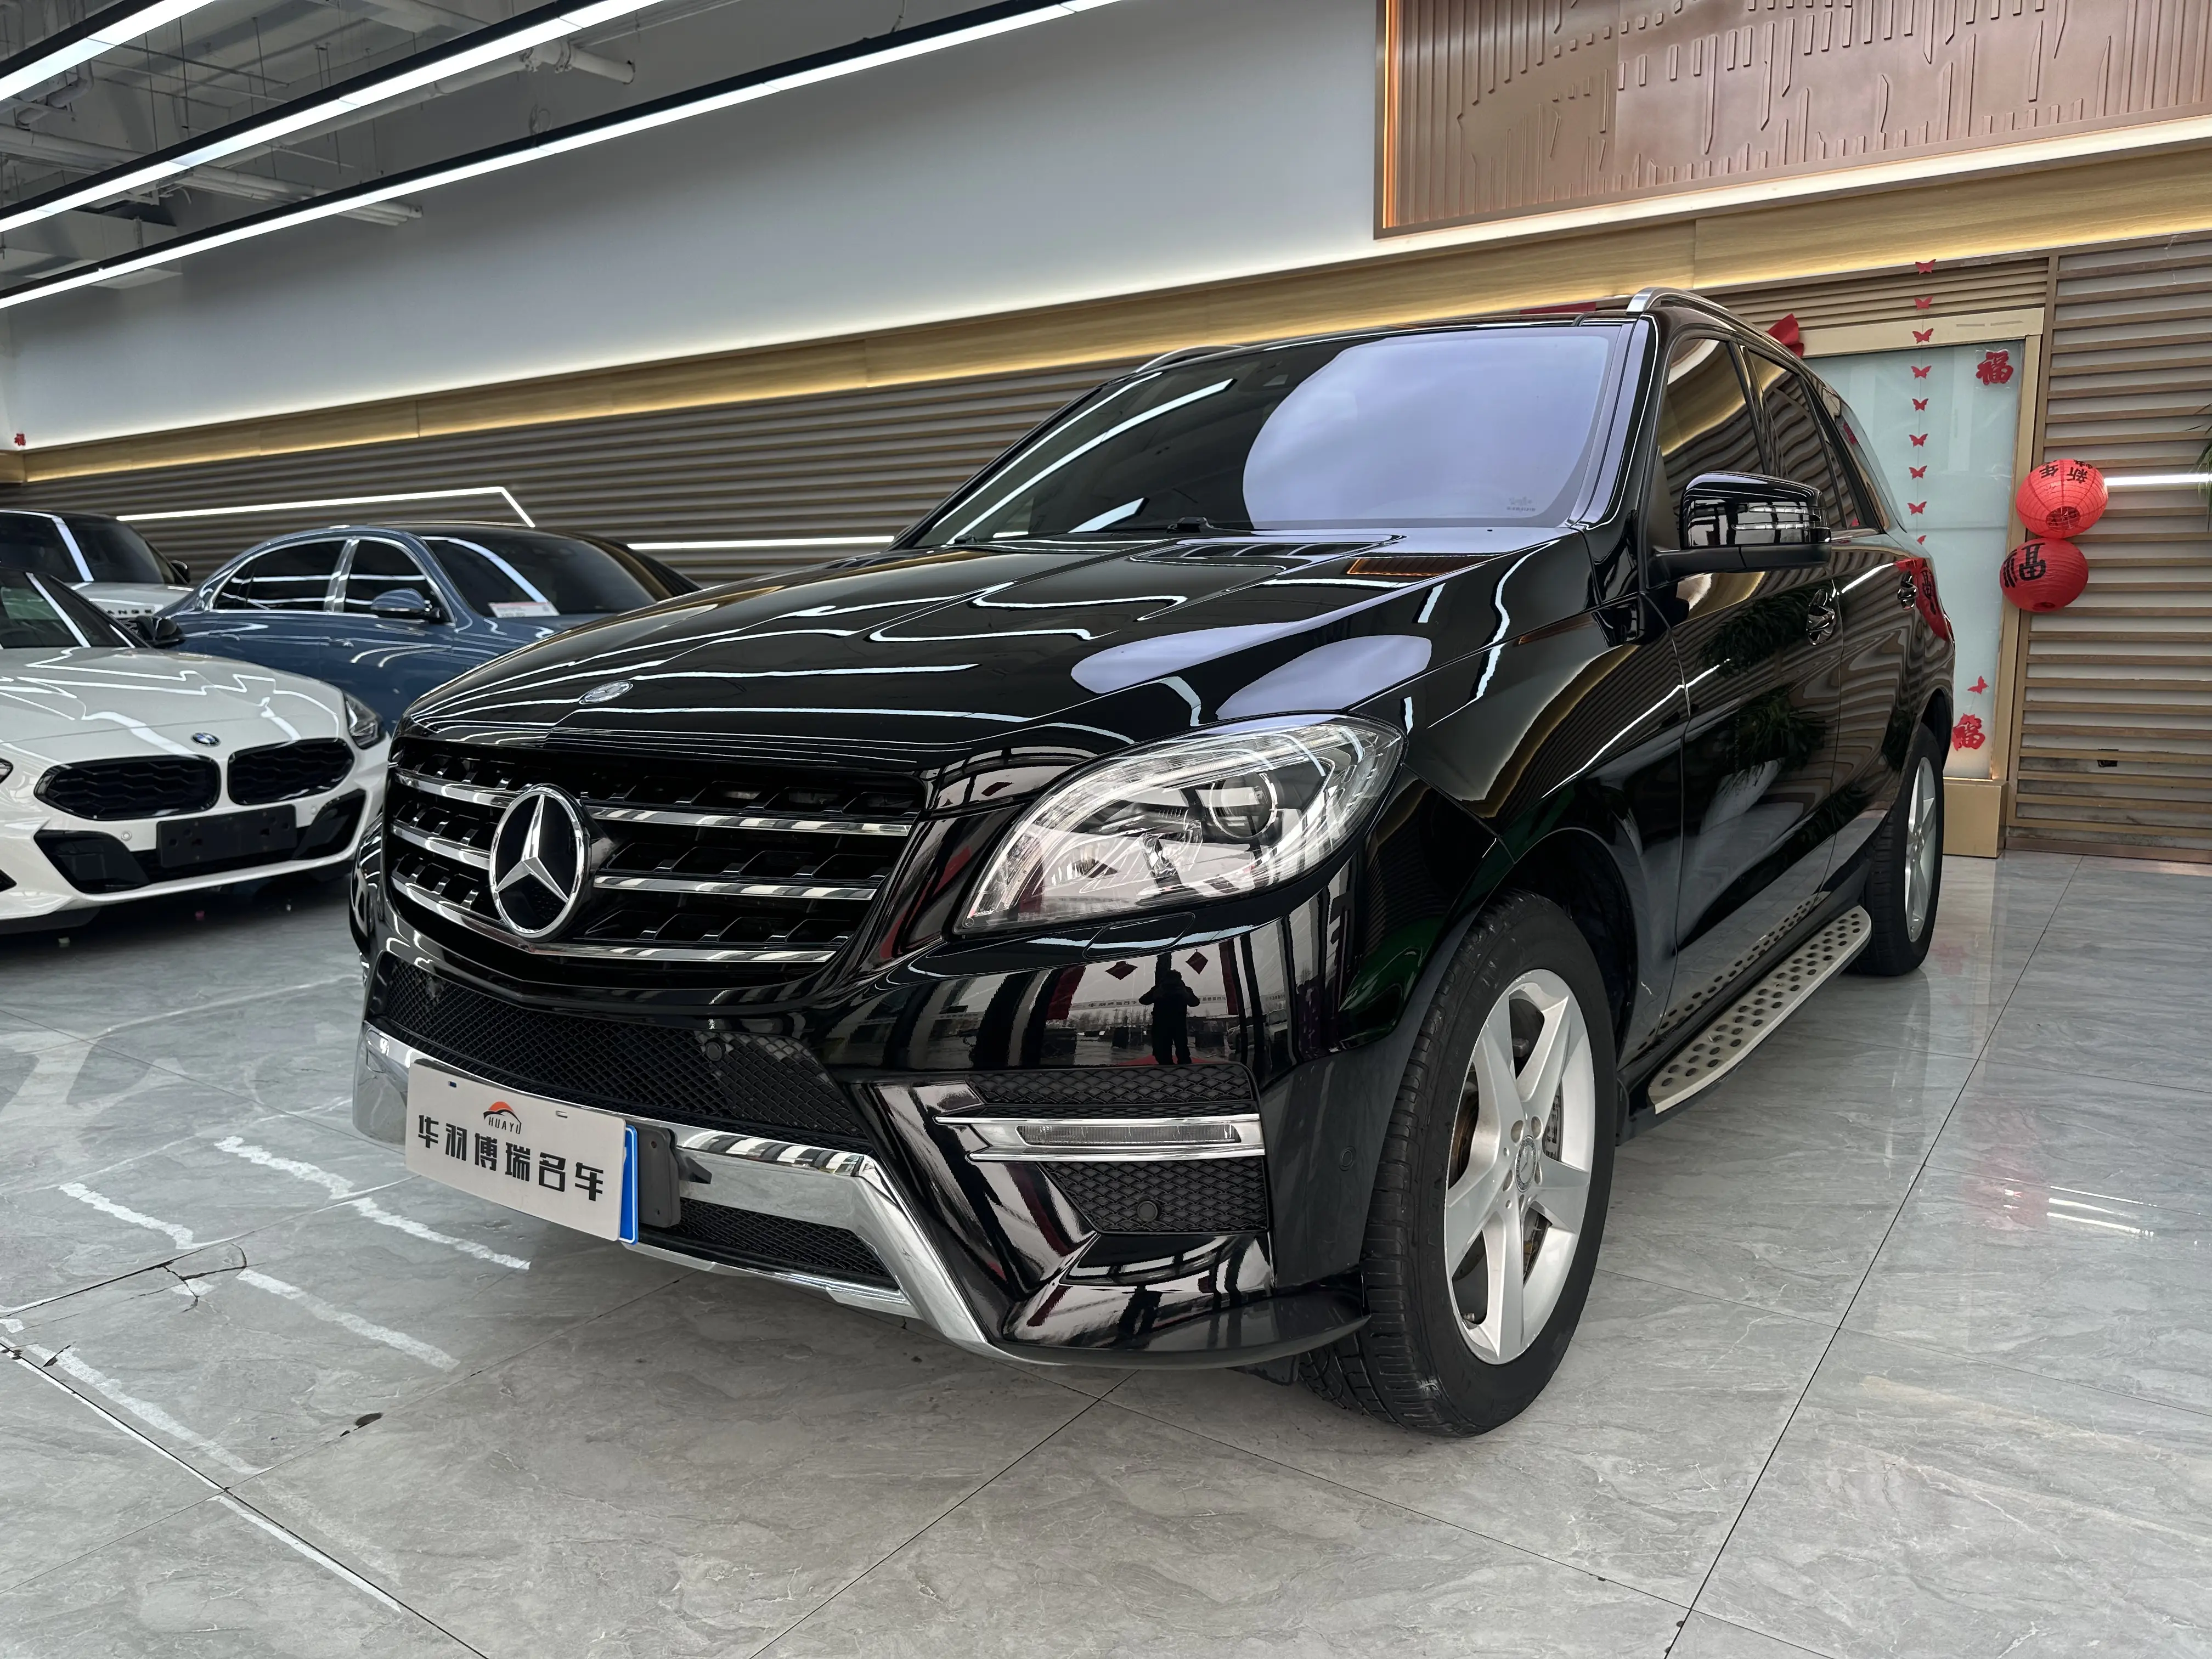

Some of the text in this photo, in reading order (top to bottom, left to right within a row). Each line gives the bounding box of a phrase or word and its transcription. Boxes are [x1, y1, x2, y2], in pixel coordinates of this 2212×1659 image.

[1976, 351, 2013, 386] 福
[488, 1116, 522, 1135] HUAYU
[418, 1115, 603, 1201] 华羽博瑞名车
